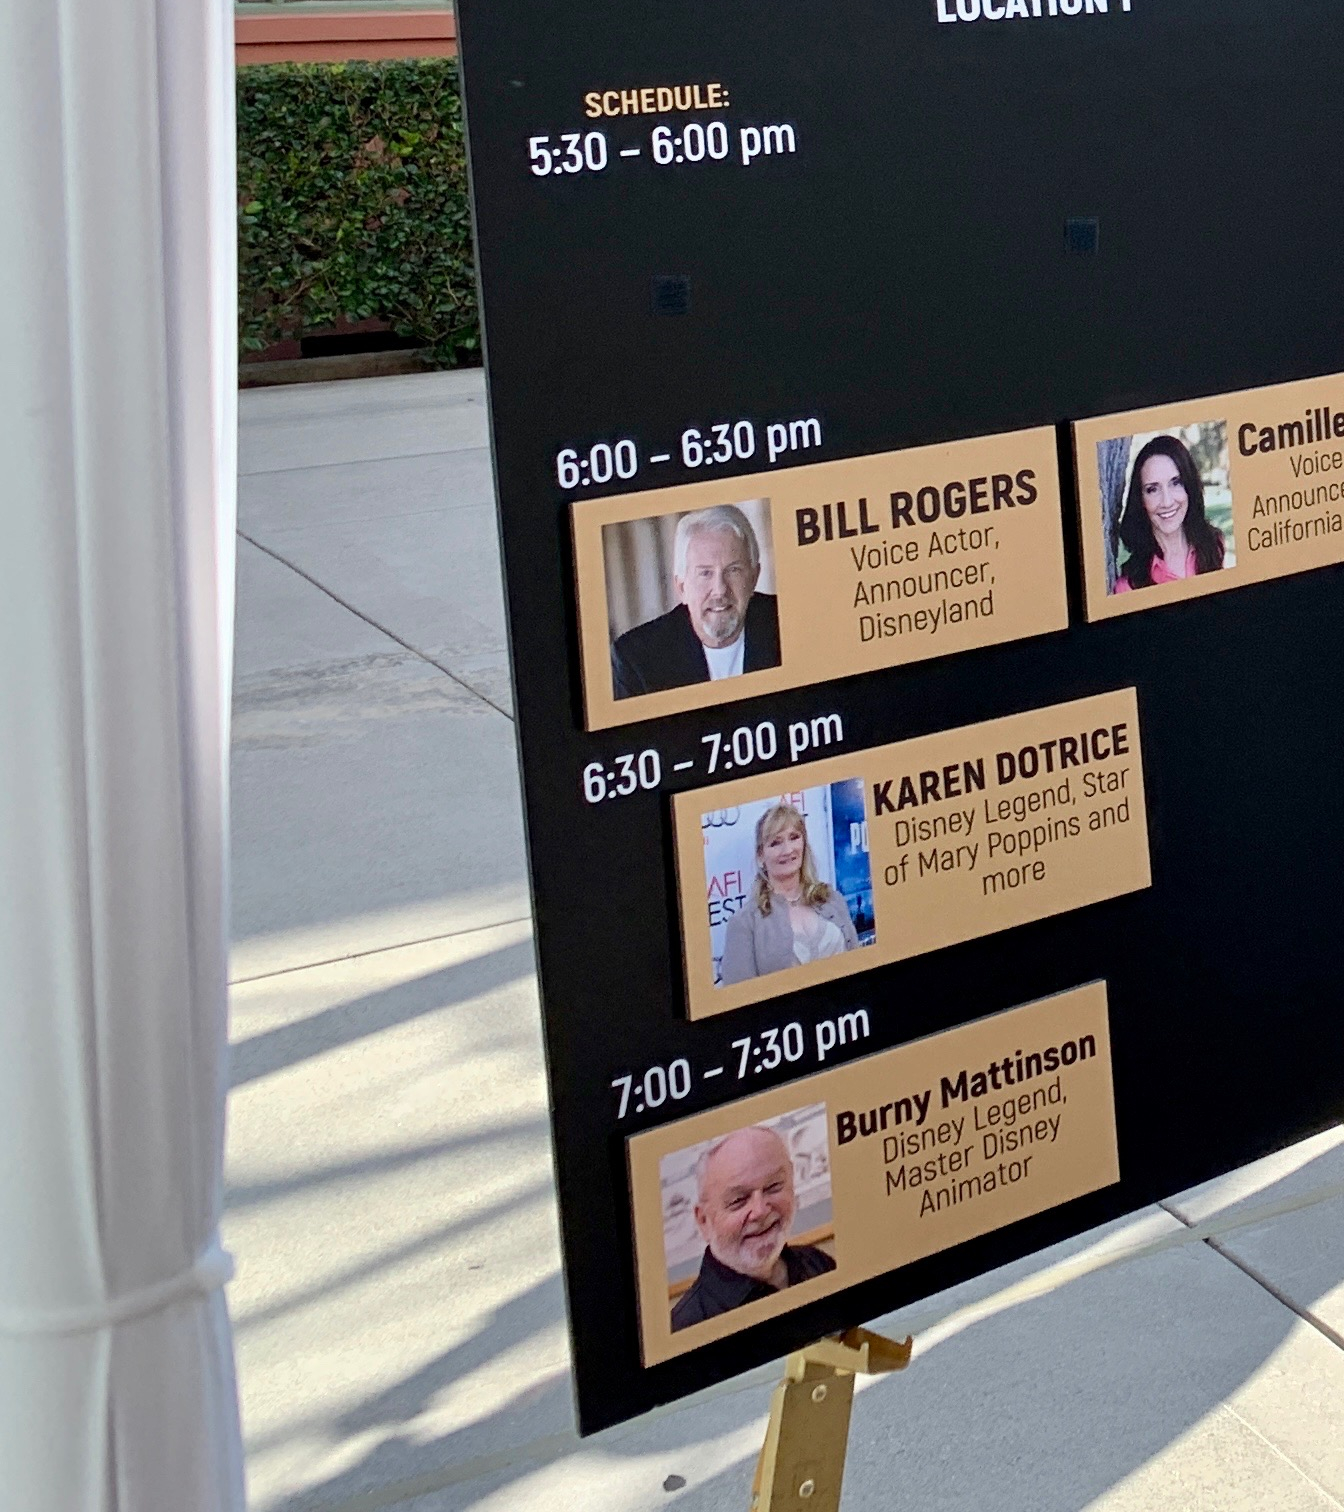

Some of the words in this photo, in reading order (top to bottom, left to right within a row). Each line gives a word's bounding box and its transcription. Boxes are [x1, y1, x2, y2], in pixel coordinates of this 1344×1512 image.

[584, 82, 731, 119] SCHEDULE:
[528, 130, 609, 177] 5:30
[651, 120, 729, 166] 6:00
[740, 122, 796, 167] pm
[556, 438, 638, 490] 6:00
[681, 419, 756, 469] 6:30
[766, 416, 823, 463] pm
[1289, 450, 1343, 479] Voice
[795, 497, 880, 547] BILL
[889, 468, 1039, 530] ROGERS
[1247, 511, 1343, 552] California
[850, 538, 920, 573] Voice
[927, 525, 1001, 560] Actor,
[852, 561, 996, 609] Announcer,
[859, 590, 995, 643] Disneyland
[582, 749, 662, 804] 6:30
[701, 724, 778, 776] 7:00
[789, 712, 845, 761] pm
[873, 758, 988, 817] KAREN
[997, 722, 1130, 786] DOTRICE
[884, 853, 909, 887] of
[918, 832, 980, 879] Mary
[987, 818, 1082, 870] Poppins
[1087, 800, 1131, 832] and
[894, 808, 977, 849] Disney
[984, 783, 1078, 827] Legend,
[1082, 764, 1131, 799] Star
[982, 863, 1047, 897] more
[611, 1057, 692, 1120] 7:00
[731, 1020, 805, 1080] 7:30
[815, 1008, 870, 1061] pm
[835, 1089, 932, 1146] Burny
[940, 1033, 1097, 1111] Mattinson
[882, 1115, 966, 1165] Disney
[973, 1077, 1069, 1132] Legend,
[885, 1141, 974, 1197] Master
[981, 1113, 1063, 1162] Disney
[919, 1156, 1034, 1219] Animator
